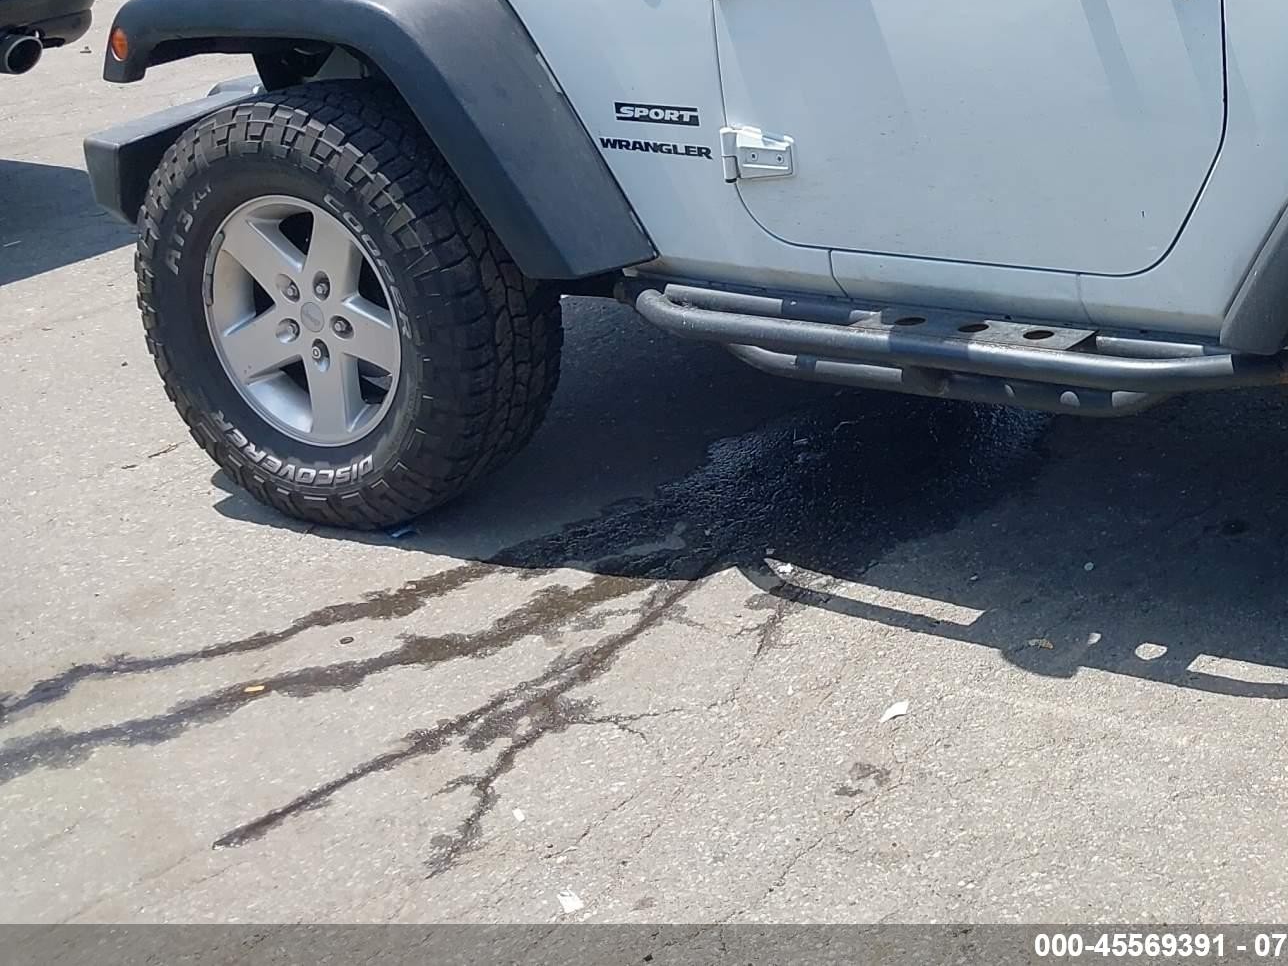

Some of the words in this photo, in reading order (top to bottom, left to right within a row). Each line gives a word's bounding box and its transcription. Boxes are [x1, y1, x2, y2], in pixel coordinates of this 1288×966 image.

[615, 105, 699, 124] SPORT
[598, 137, 713, 160] WRANGLER
[323, 193, 413, 339] COOPER
[212, 409, 375, 485] DISCOVERER
